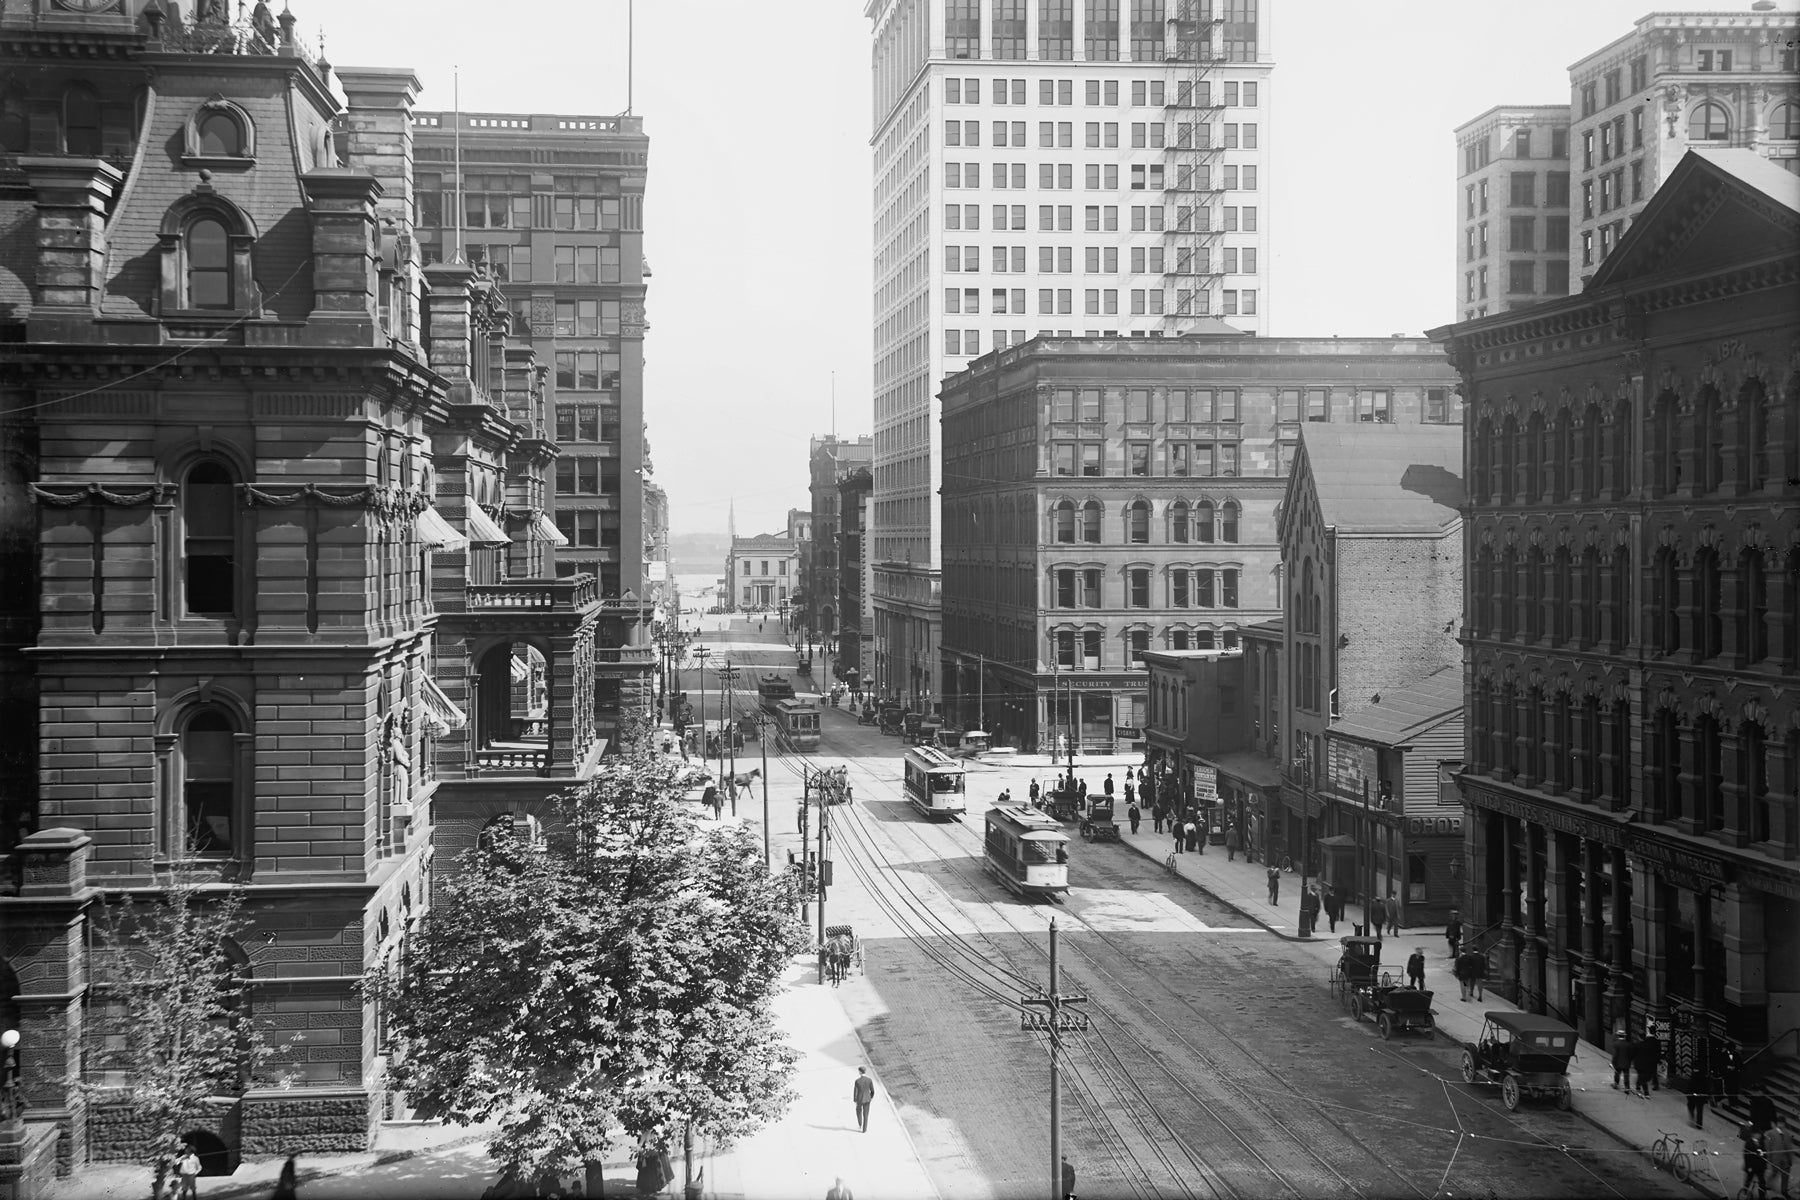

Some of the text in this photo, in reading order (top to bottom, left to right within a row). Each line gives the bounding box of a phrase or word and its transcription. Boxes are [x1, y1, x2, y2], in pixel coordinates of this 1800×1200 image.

[1718, 340, 1746, 361] 1874
[1410, 817, 1461, 834] CHOP
[1655, 1020, 1671, 1031] SHOE
[1655, 1031, 1671, 1041] SHINE
